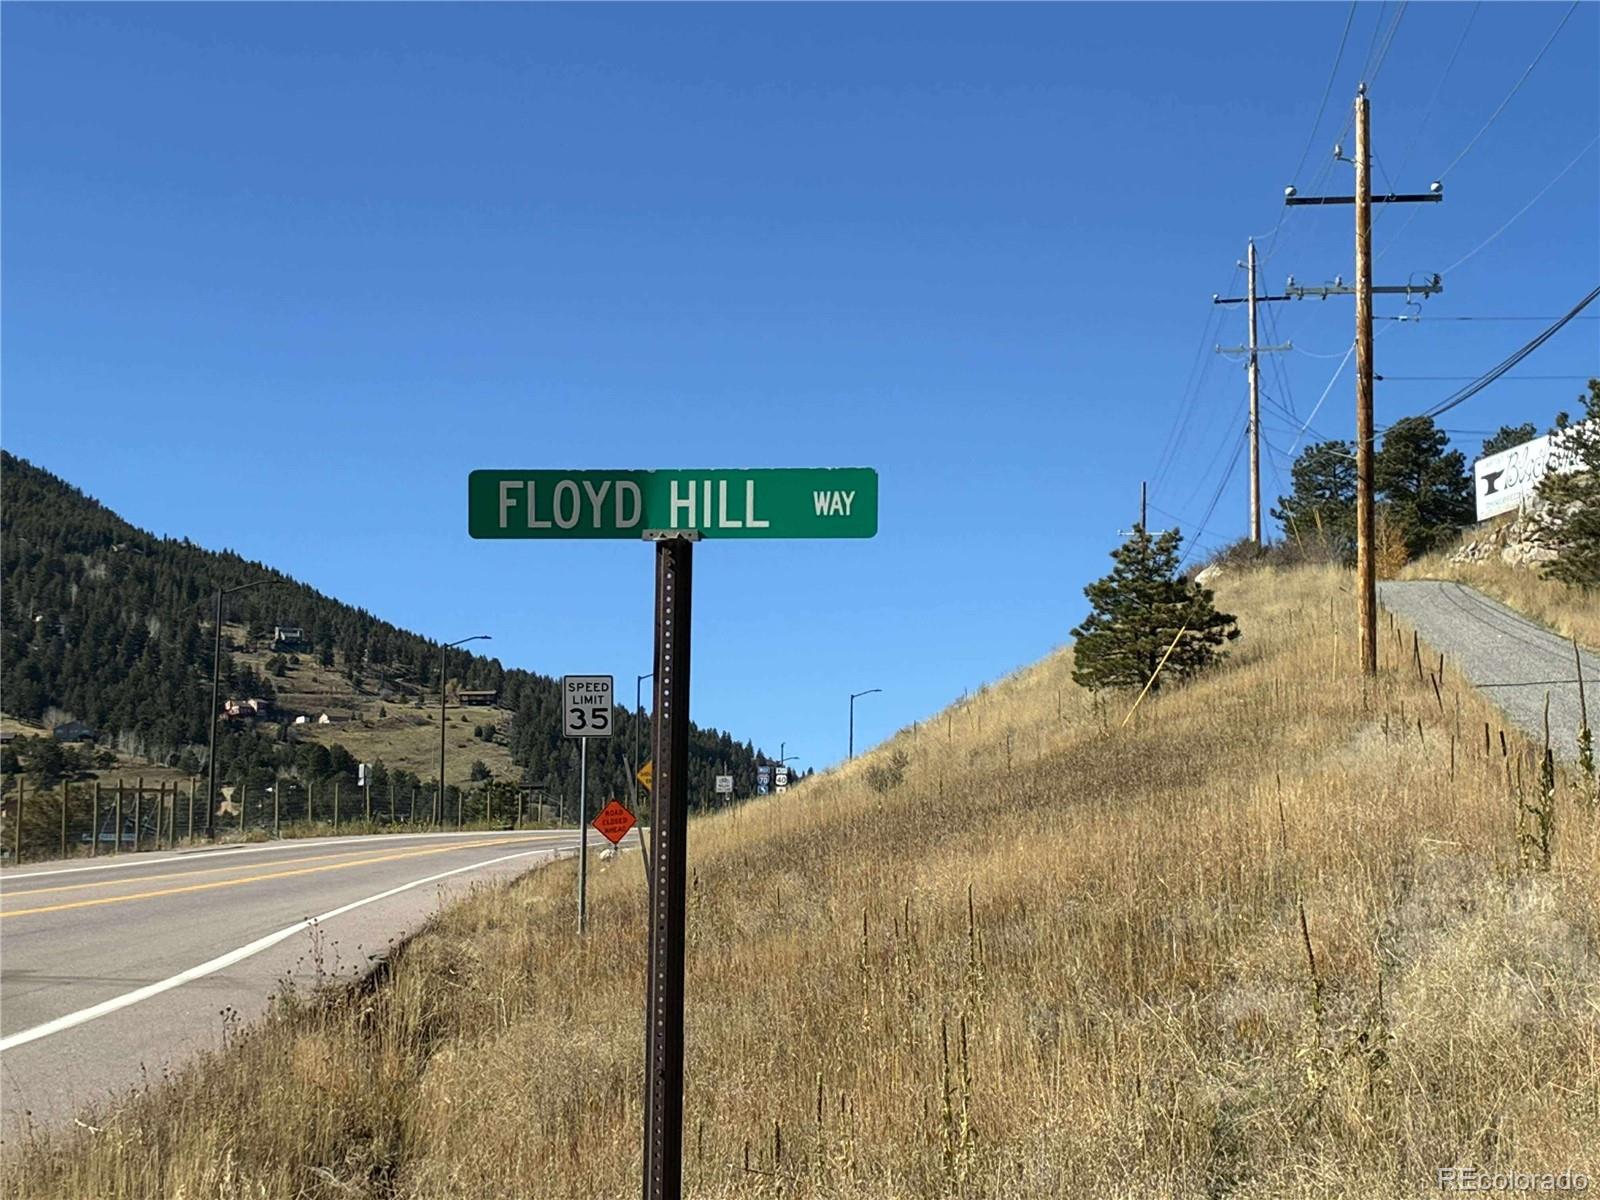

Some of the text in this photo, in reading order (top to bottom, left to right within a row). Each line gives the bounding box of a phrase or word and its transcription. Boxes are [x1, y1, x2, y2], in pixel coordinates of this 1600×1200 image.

[498, 479, 855, 528] FLOYD HILL WAY
[568, 682, 609, 692] SPEED
[572, 695, 604, 705] LIMIT
[569, 707, 608, 730] 35
[776, 776, 786, 784] 40
[602, 817, 628, 826] CLOSED
